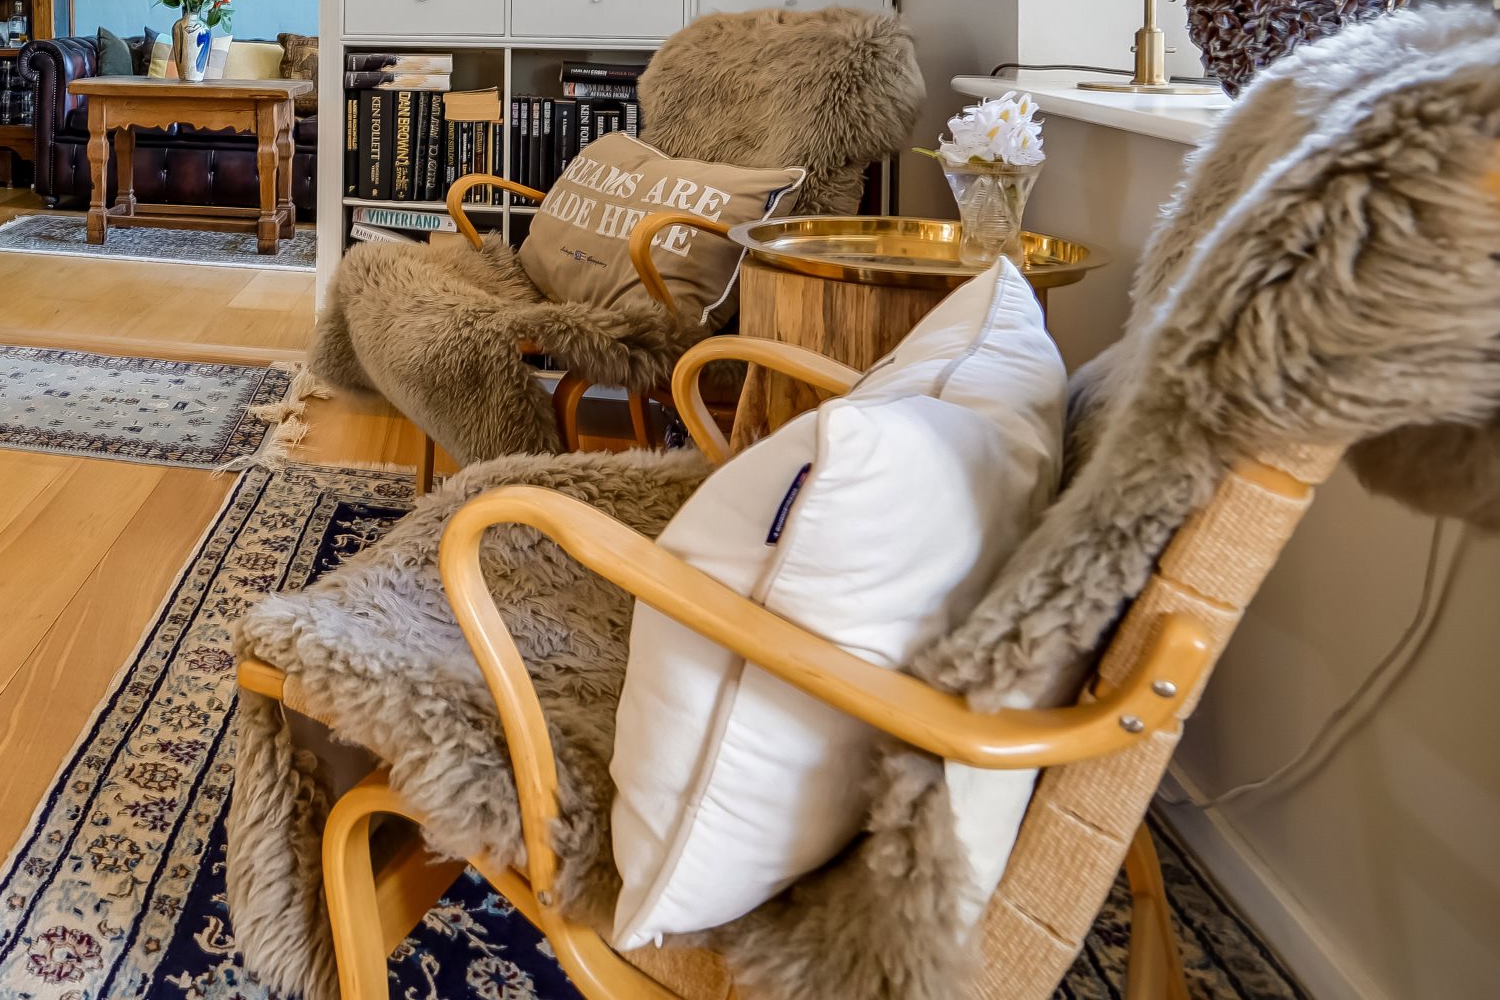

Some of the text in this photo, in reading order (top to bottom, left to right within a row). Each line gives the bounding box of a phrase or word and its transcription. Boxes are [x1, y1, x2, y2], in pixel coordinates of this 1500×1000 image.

[371, 96, 380, 160] KEN FOLLETT
[397, 91, 410, 159] DAN BROWN
[580, 105, 589, 123] KEN
[367, 209, 441, 229] VINTERLAND
[563, 156, 731, 222] REAMS ARE
